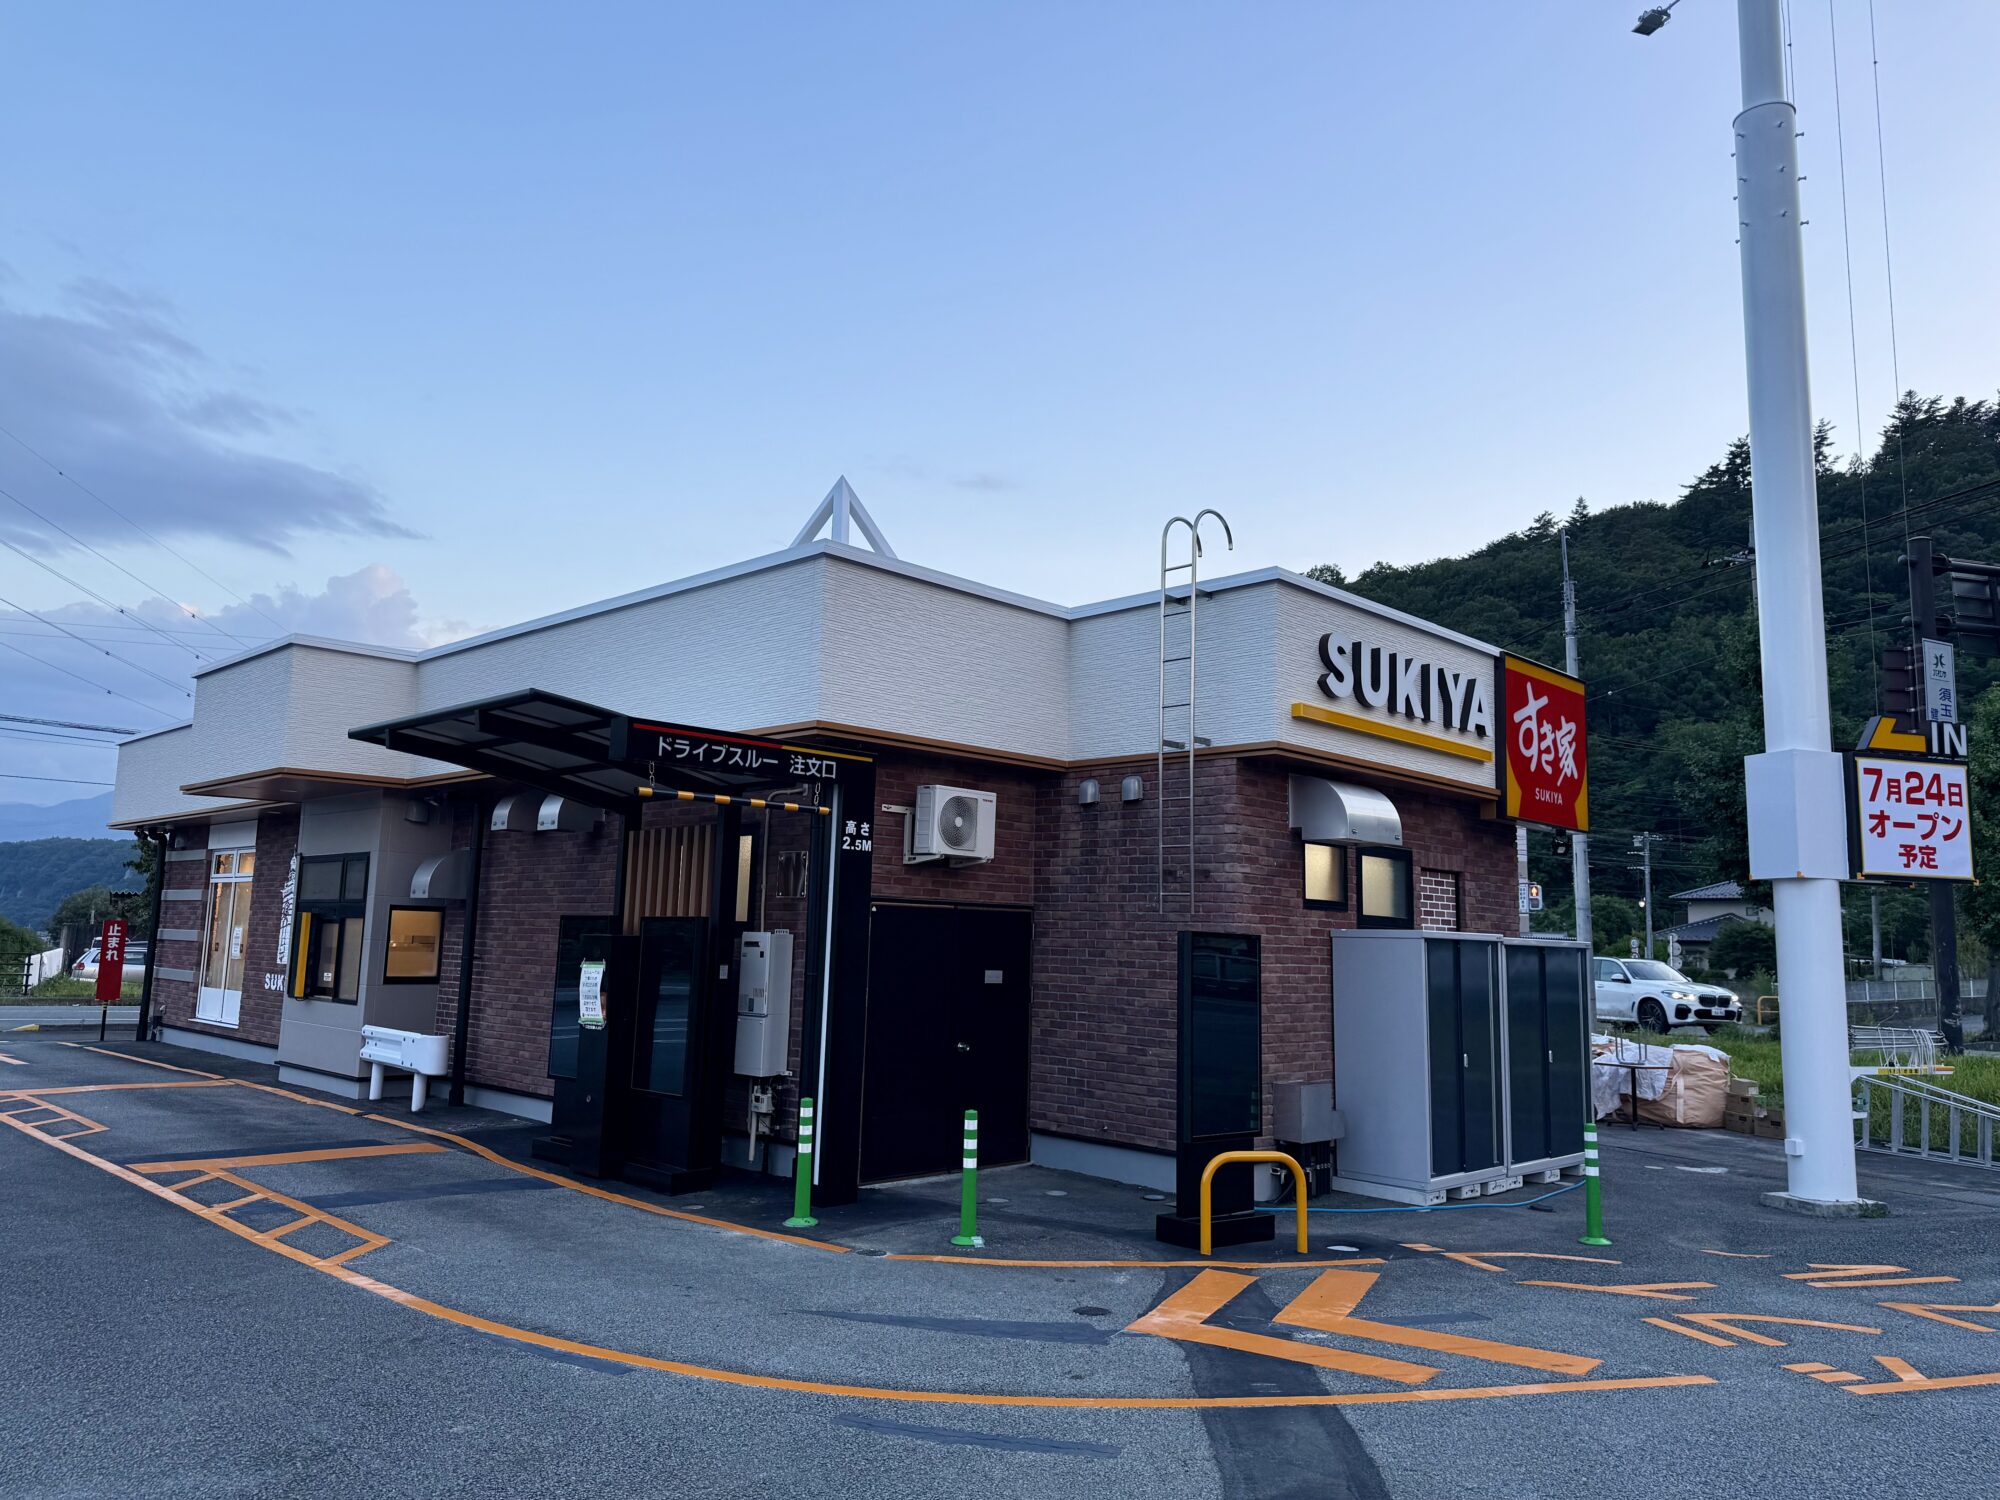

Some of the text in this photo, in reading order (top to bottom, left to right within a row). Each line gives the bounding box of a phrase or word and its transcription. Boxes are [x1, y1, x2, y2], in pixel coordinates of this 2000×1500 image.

[1318, 632, 1493, 738] SUKIYA
[1939, 687, 1952, 718] 須玉
[1513, 682, 1579, 787] すき家
[1931, 722, 1967, 756] IN
[658, 736, 836, 779] ドライブスルー 注文口
[1535, 787, 1563, 806] SUKIYA
[1863, 767, 1964, 808] 7月24日
[845, 820, 870, 837] 高さ
[1868, 810, 1963, 842] オープン
[842, 836, 872, 853] 2.5M
[1898, 844, 1939, 870] 予定
[105, 923, 121, 961] 止まれ
